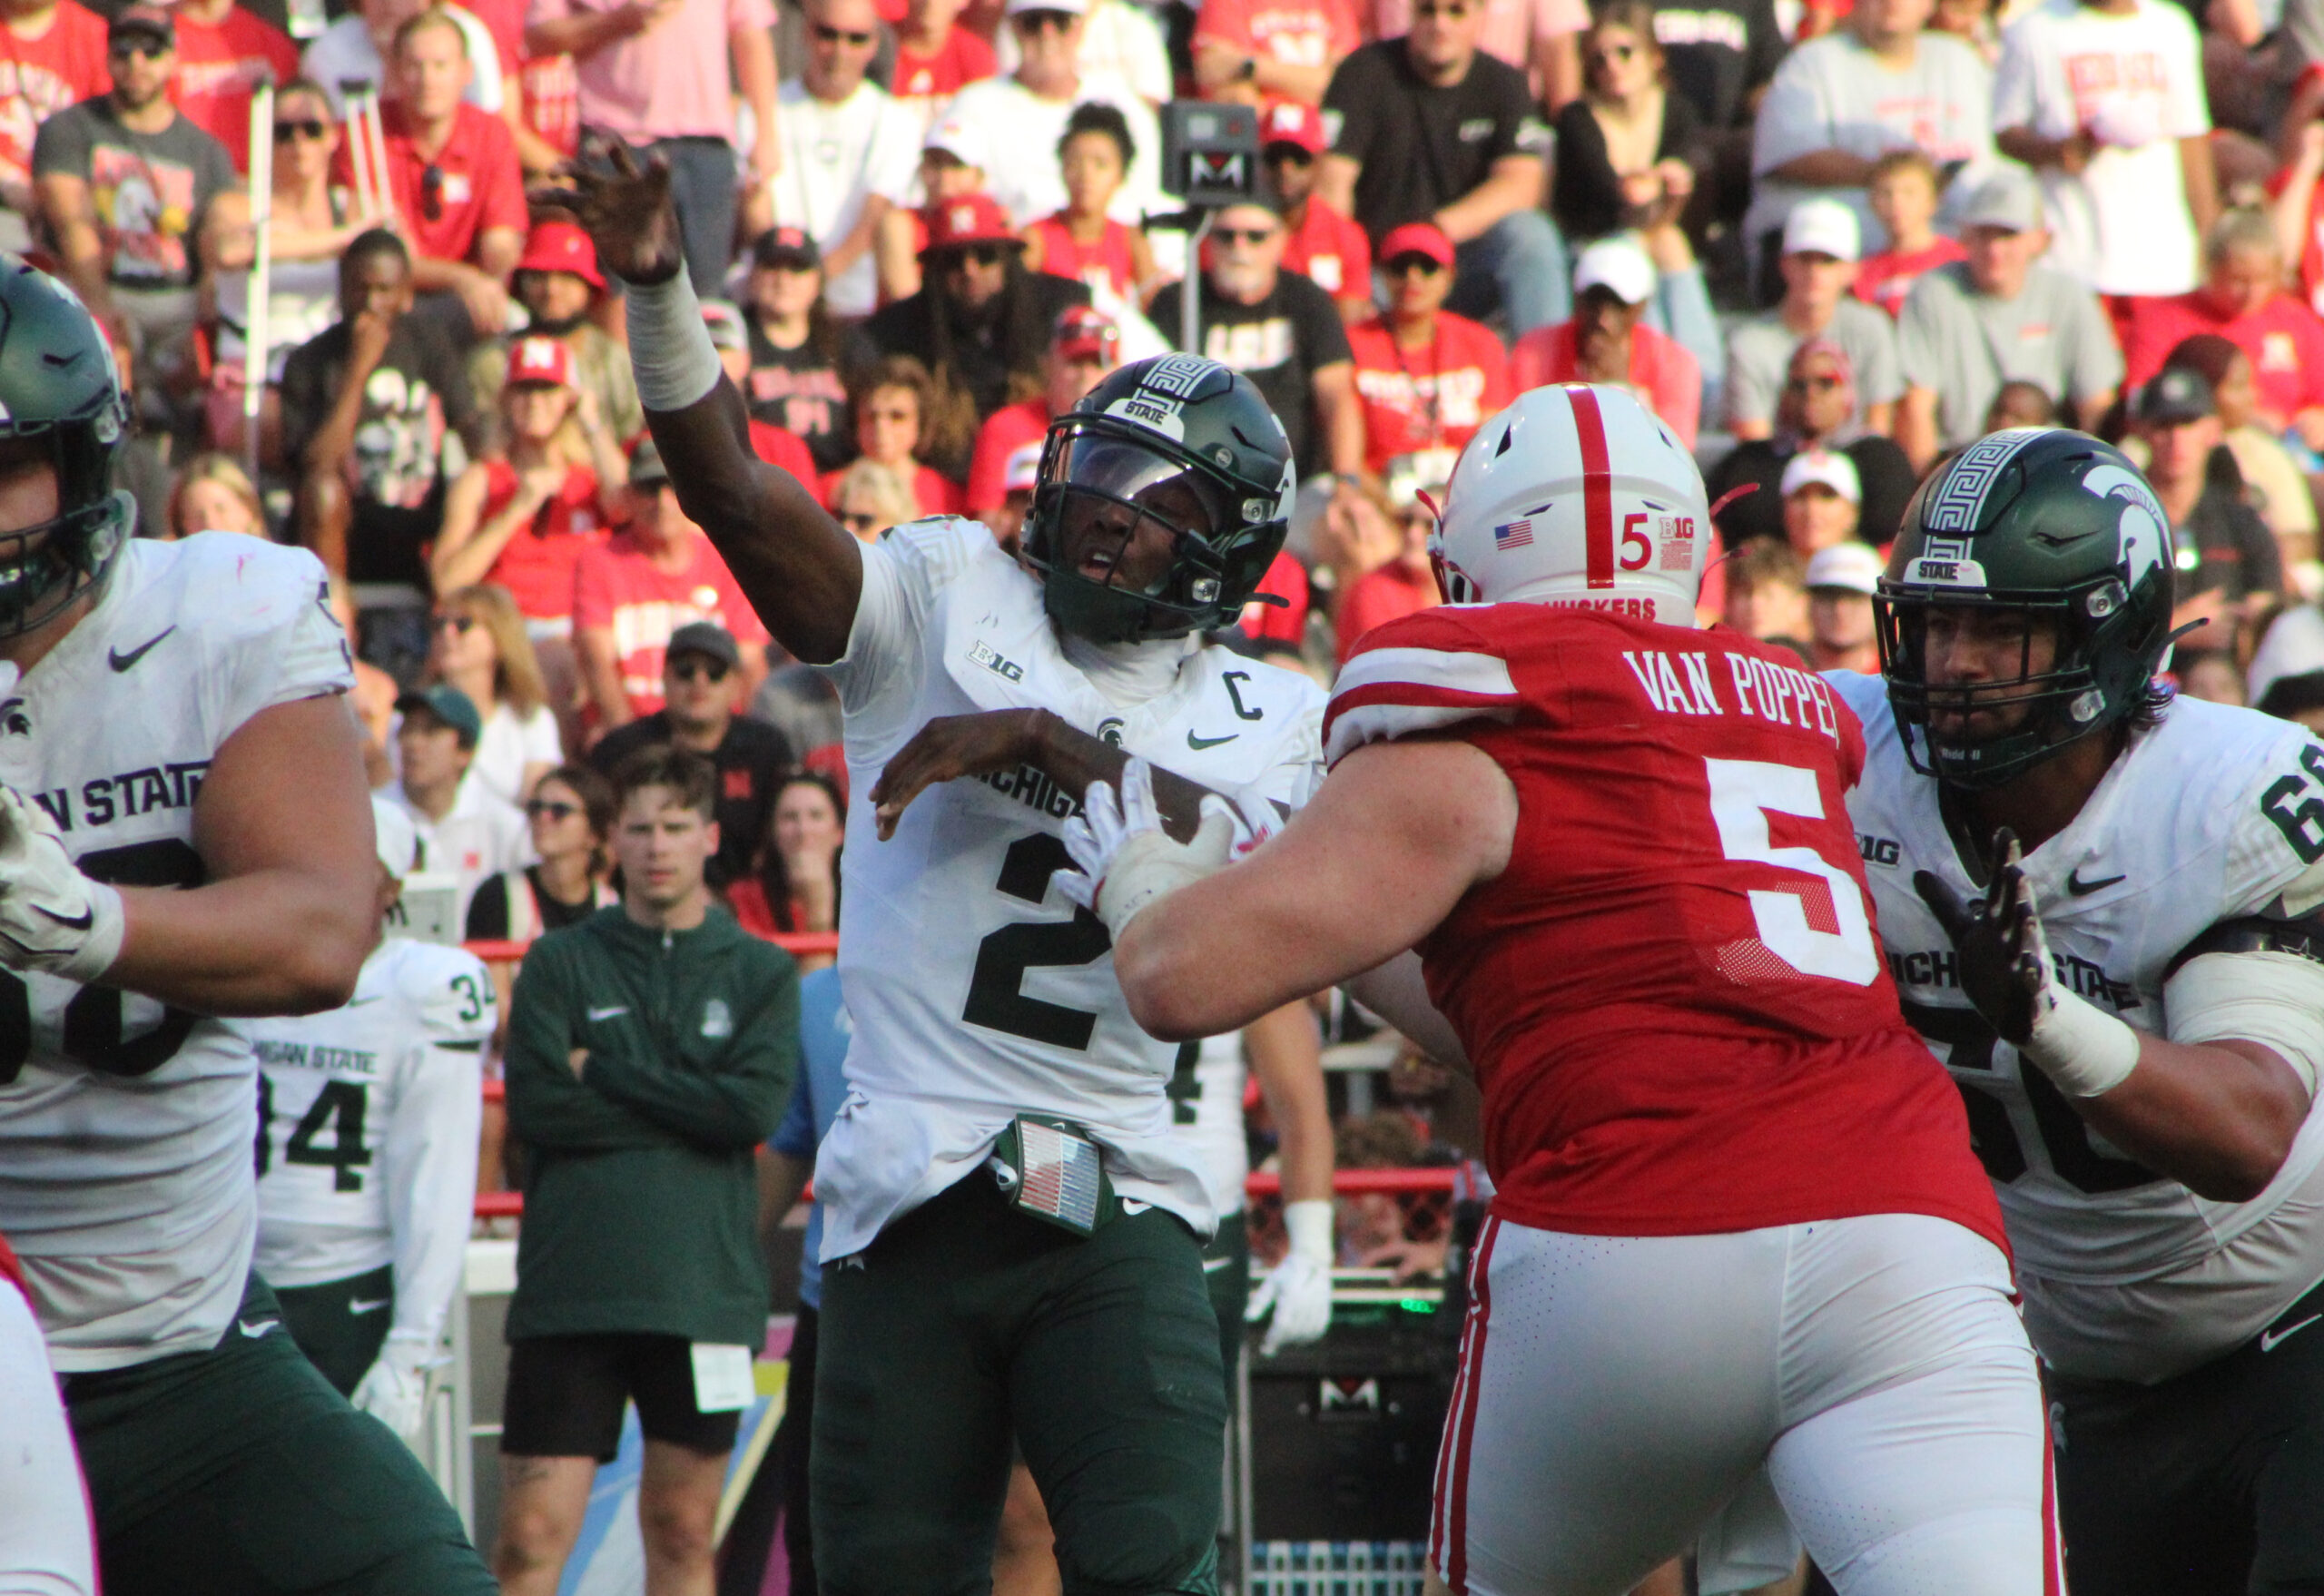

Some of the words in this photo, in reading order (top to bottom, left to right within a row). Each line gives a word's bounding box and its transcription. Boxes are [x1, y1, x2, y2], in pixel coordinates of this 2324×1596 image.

[1125, 400, 1168, 425] STATE
[1620, 513, 1652, 571] 5
[1918, 561, 1960, 580] STATE
[1222, 671, 1263, 721] C
[1622, 651, 1724, 715] VAN
[1724, 652, 1840, 750] POPPE
[1703, 757, 1880, 987] 5
[961, 832, 1113, 1051] 2
[312, 1046, 378, 1074] STATE
